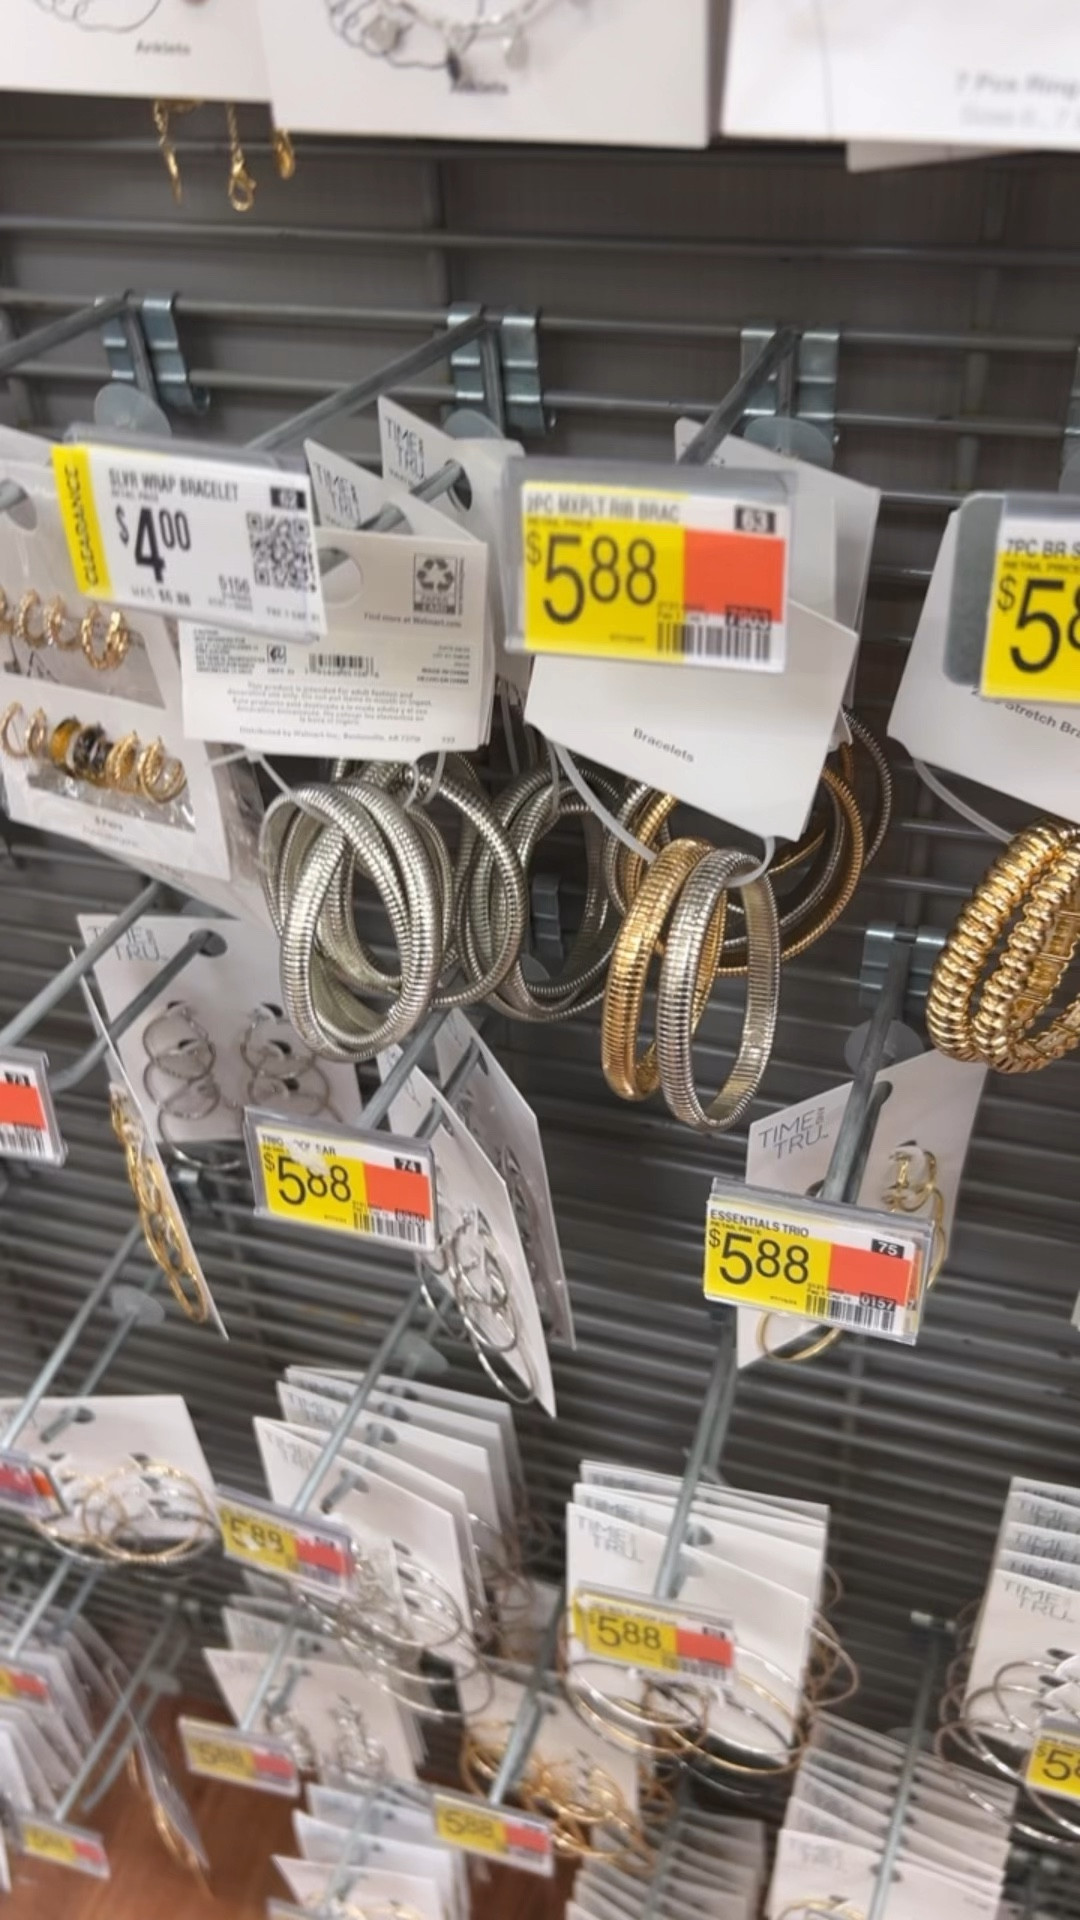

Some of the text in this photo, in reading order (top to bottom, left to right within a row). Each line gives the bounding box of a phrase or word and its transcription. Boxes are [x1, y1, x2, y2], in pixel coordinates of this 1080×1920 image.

[179, 477, 238, 504] BRACELET
[633, 727, 694, 763] Bracelets
[758, 1109, 817, 1149] TIME
[710, 1209, 810, 1238] ESSENTIALS TRIO
[877, 1241, 899, 1256] 75
